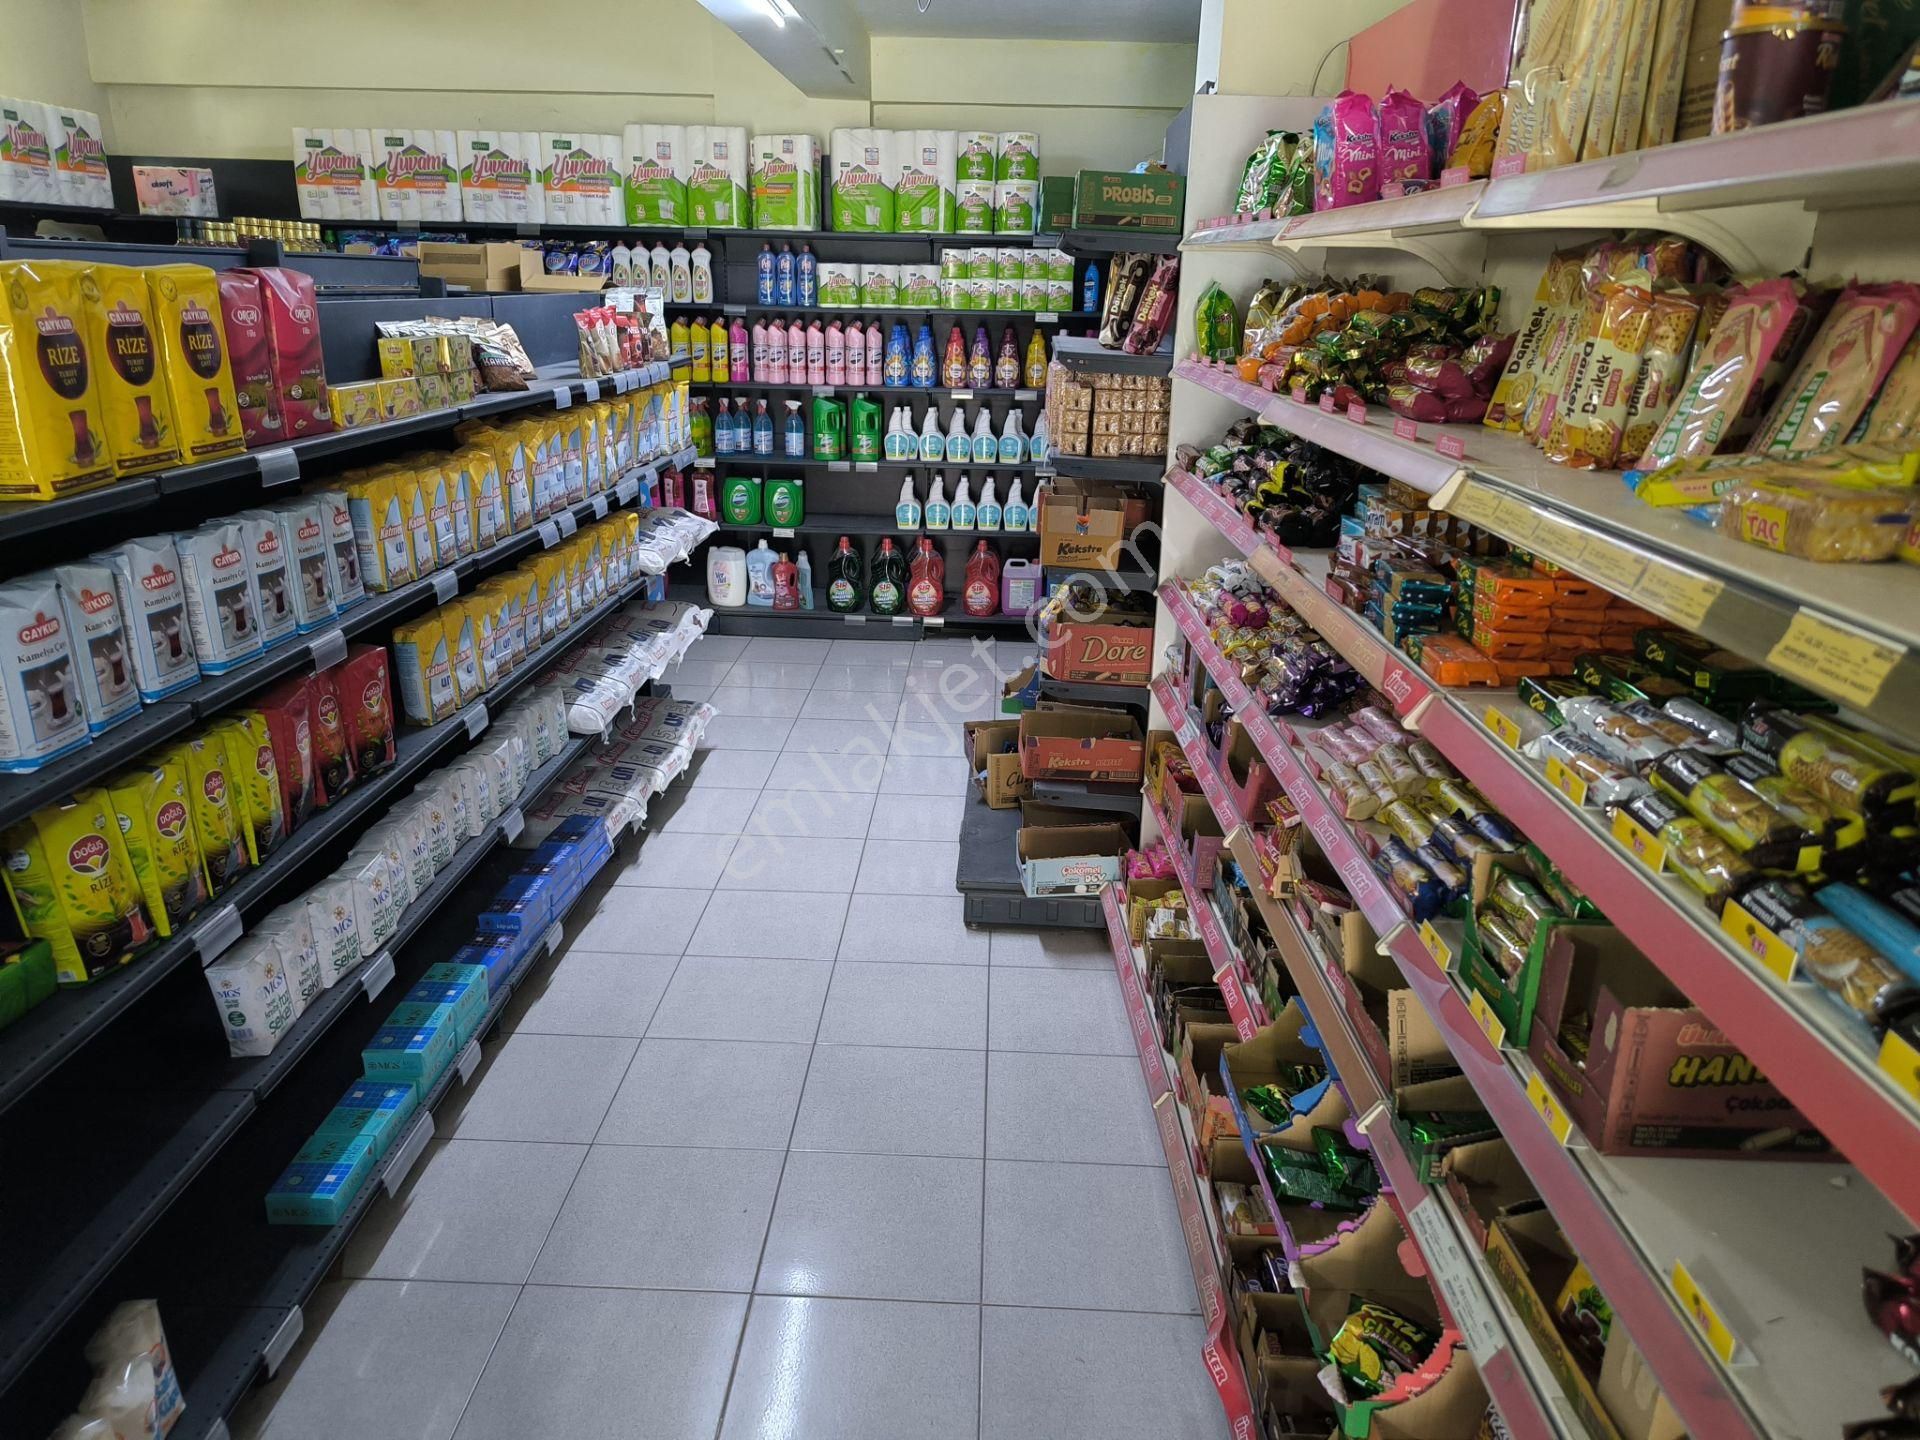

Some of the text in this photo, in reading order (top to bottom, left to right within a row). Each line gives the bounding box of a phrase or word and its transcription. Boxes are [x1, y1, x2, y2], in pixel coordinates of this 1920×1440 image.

[1346, 148, 1375, 162] Mini
[1385, 147, 1421, 160] Mini
[306, 151, 356, 182] Yuvam
[386, 151, 442, 185] Yuvam
[471, 154, 524, 185] Yuvam
[551, 154, 608, 187] Yuvam
[632, 164, 673, 186] Yuvam
[692, 167, 730, 186] Yuvam
[762, 161, 797, 182] Yuvam
[838, 171, 880, 193] Yuvam
[900, 172, 936, 192] Yuvam
[1103, 184, 1154, 203] PROBİS
[1111, 277, 1128, 313] Dankek
[1137, 284, 1160, 322] Dankek
[117, 337, 148, 354] RİZE
[188, 333, 214, 350] RİZE
[1507, 306, 1548, 374] Dankek
[47, 345, 80, 366] RİZE
[1654, 434, 1676, 455] 9
[835, 583, 847, 591] SIR
[879, 582, 891, 590] SIR
[971, 583, 985, 591] SIR
[1081, 636, 1146, 663] Dore
[1049, 757, 1090, 768] Kekstra
[1269, 745, 1288, 773] ÜLKER
[1290, 777, 1312, 809] ÜLKER
[1314, 814, 1340, 850] ÜLKER
[73, 840, 104, 861] DOĞUŞ
[1343, 856, 1371, 897] ÜLKER
[333, 917, 353, 937] MGS
[217, 988, 241, 998] MGS
[264, 974, 284, 996] MGS
[1223, 976, 1238, 1008] ÜLKER
[1238, 1018, 1253, 1042] ÜLK
